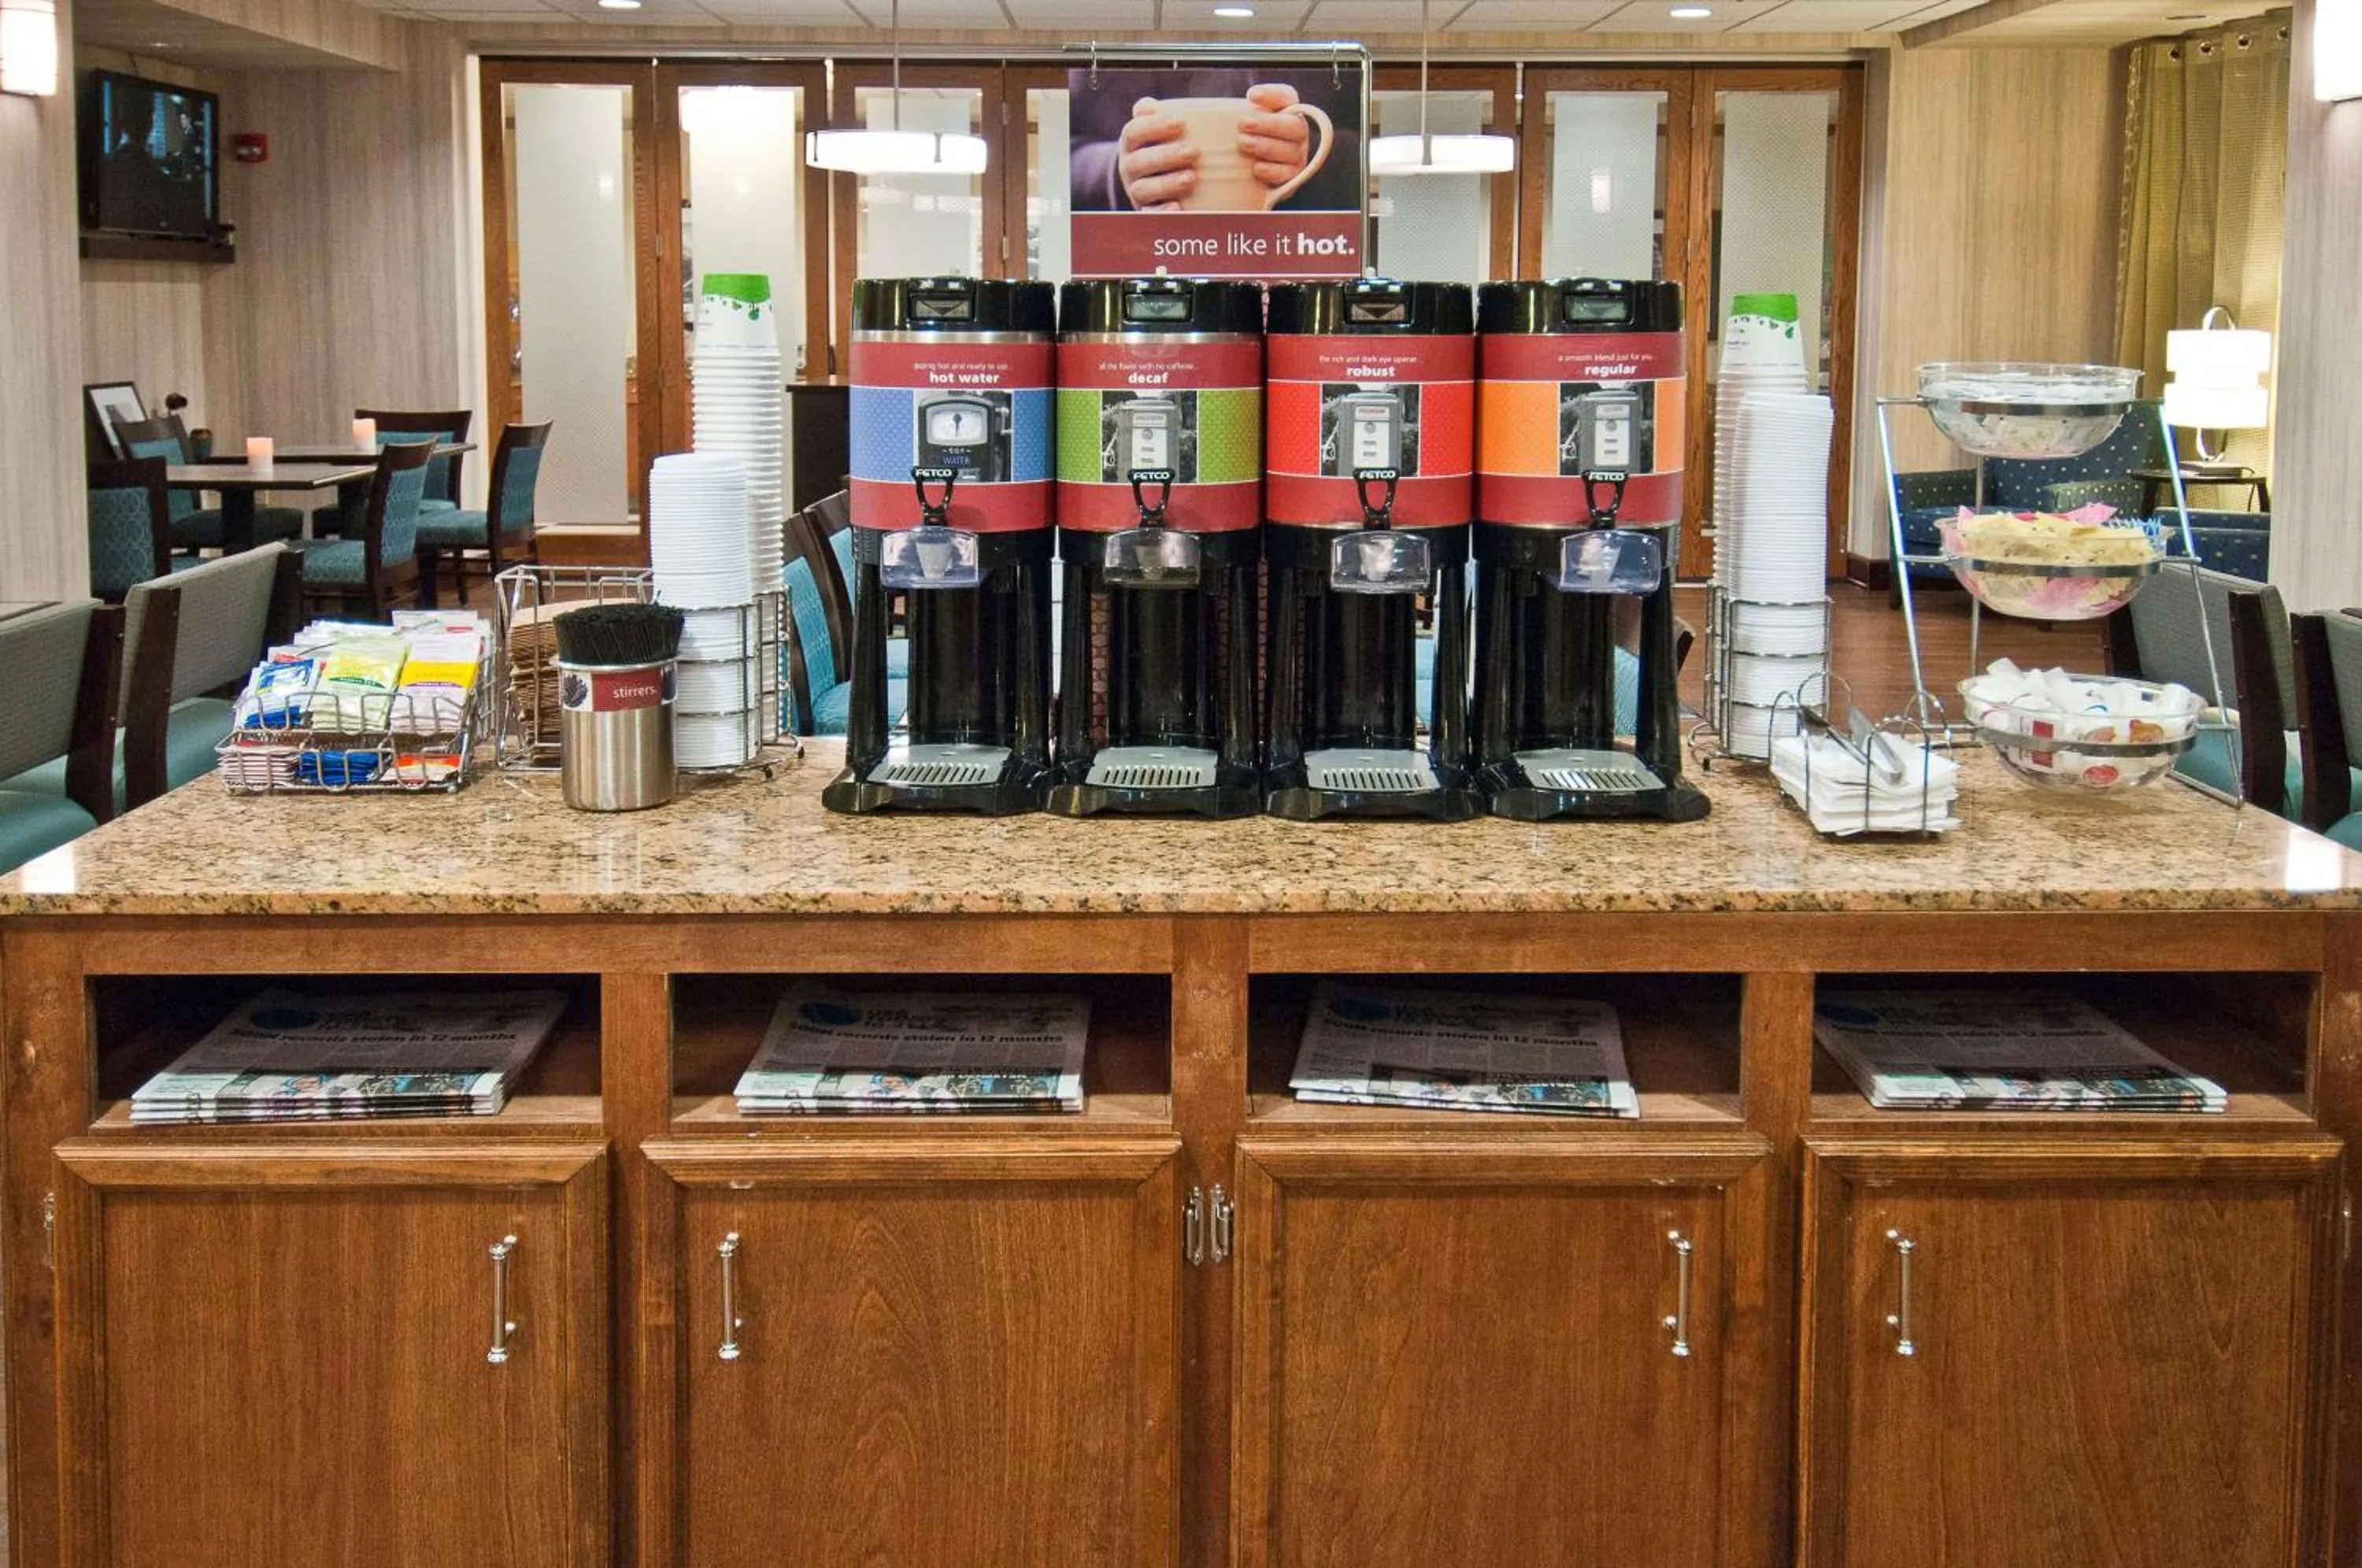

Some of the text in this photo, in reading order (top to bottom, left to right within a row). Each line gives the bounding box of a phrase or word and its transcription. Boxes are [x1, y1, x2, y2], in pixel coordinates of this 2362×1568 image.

[1153, 232, 1356, 256] some like it hot.
[937, 362, 950, 371] hot
[951, 362, 965, 371] and
[1347, 364, 1396, 377] robust
[1585, 364, 1638, 378] regular
[929, 371, 1000, 383] hot water
[1127, 371, 1168, 383] decaf
[942, 456, 971, 465] WATER
[916, 468, 953, 477] FETCO
[1133, 472, 1170, 480] FETCO
[1360, 470, 1395, 479] FETCO
[1589, 472, 1624, 481] FETCO
[612, 685, 658, 700] stirrers.
[351, 1033, 405, 1044] stolen
[409, 1032, 427, 1043] in
[431, 1033, 447, 1043] 12
[450, 1031, 517, 1043] months
[836, 1032, 899, 1041] records
[903, 1033, 955, 1042] stolen
[959, 1034, 976, 1042] in
[980, 1034, 994, 1043] 12
[999, 1034, 1063, 1043] months
[1436, 1030, 1488, 1040] stolen
[1493, 1034, 1509, 1042] in
[1514, 1034, 1530, 1044] 12
[1533, 1036, 1597, 1047] months
